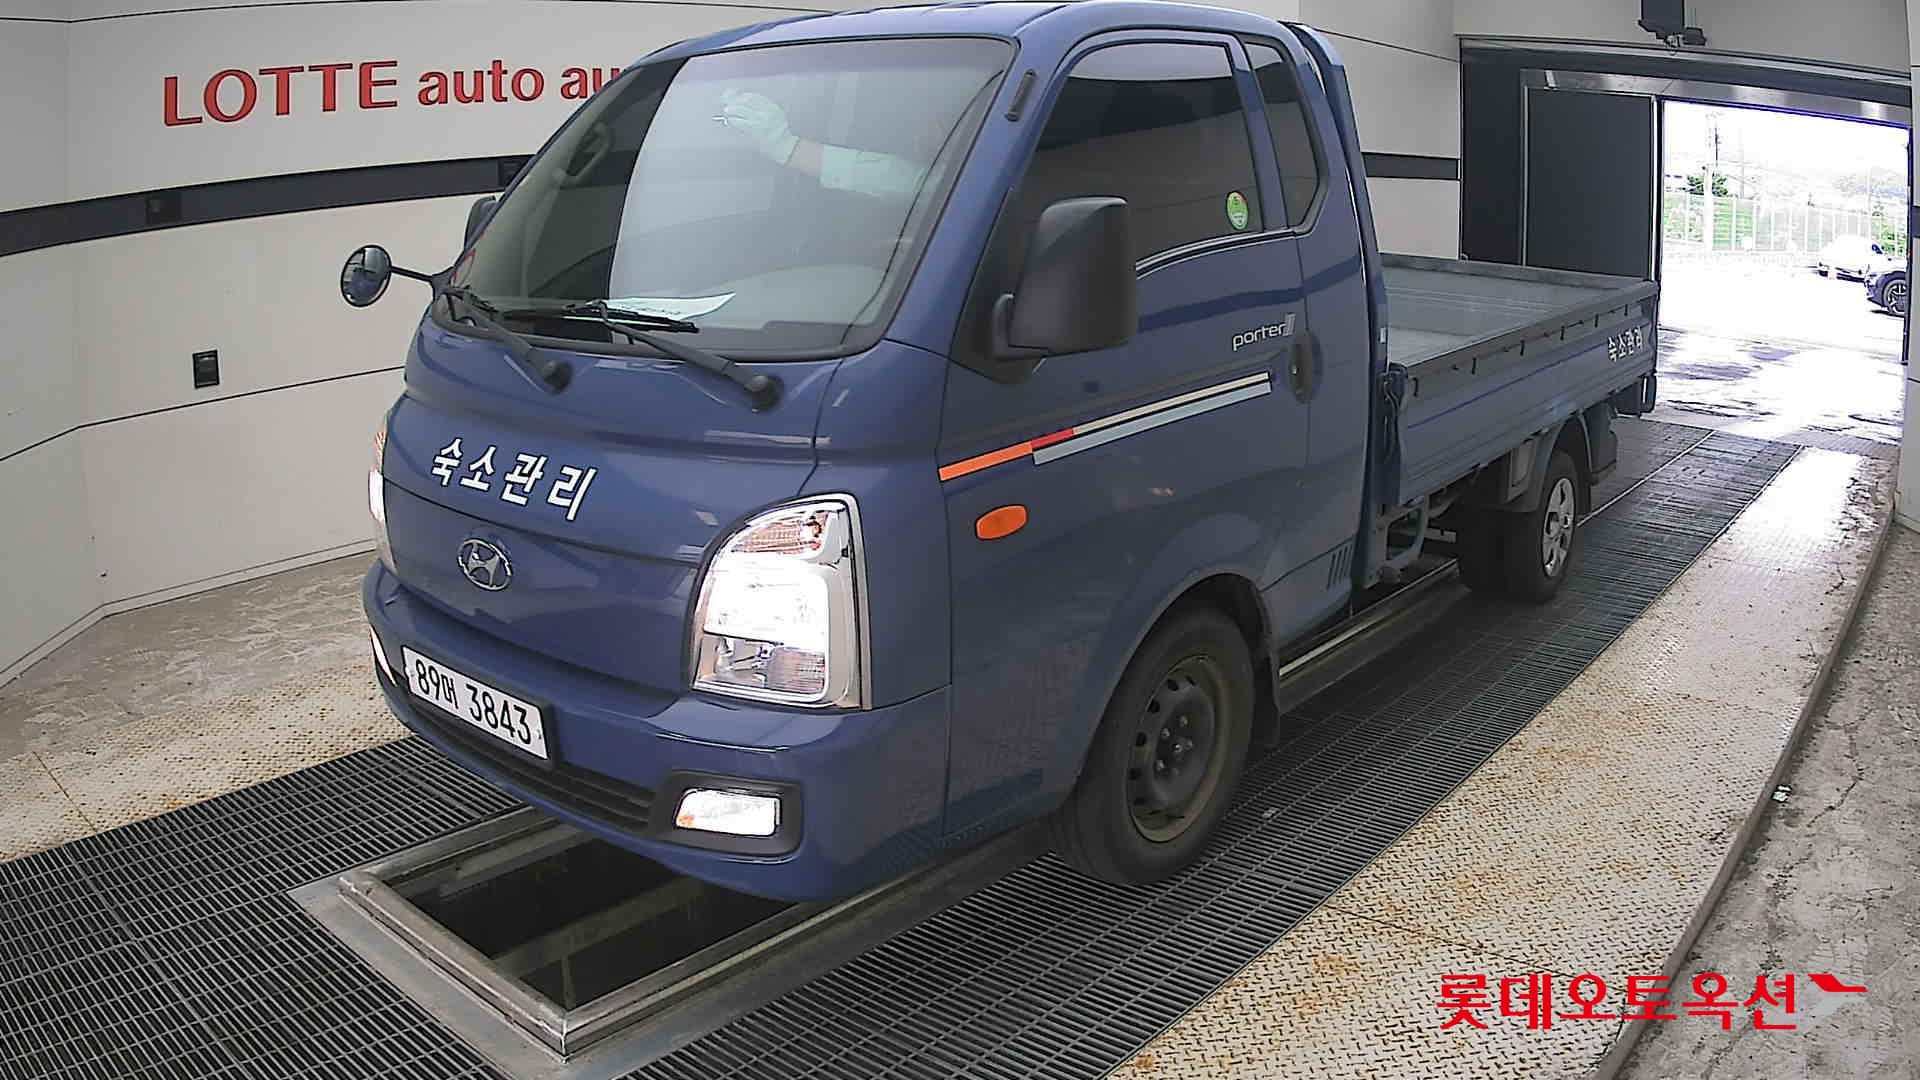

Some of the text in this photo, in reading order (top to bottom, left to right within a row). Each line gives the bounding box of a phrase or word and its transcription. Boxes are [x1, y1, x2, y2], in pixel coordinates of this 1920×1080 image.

[164, 60, 398, 126] LOTTE
[417, 59, 545, 106] auto
[1232, 323, 1287, 352] porter
[1608, 326, 1643, 362] 숙소관리
[431, 438, 597, 521] 숙소관리
[415, 658, 531, 745] 89머 3843
